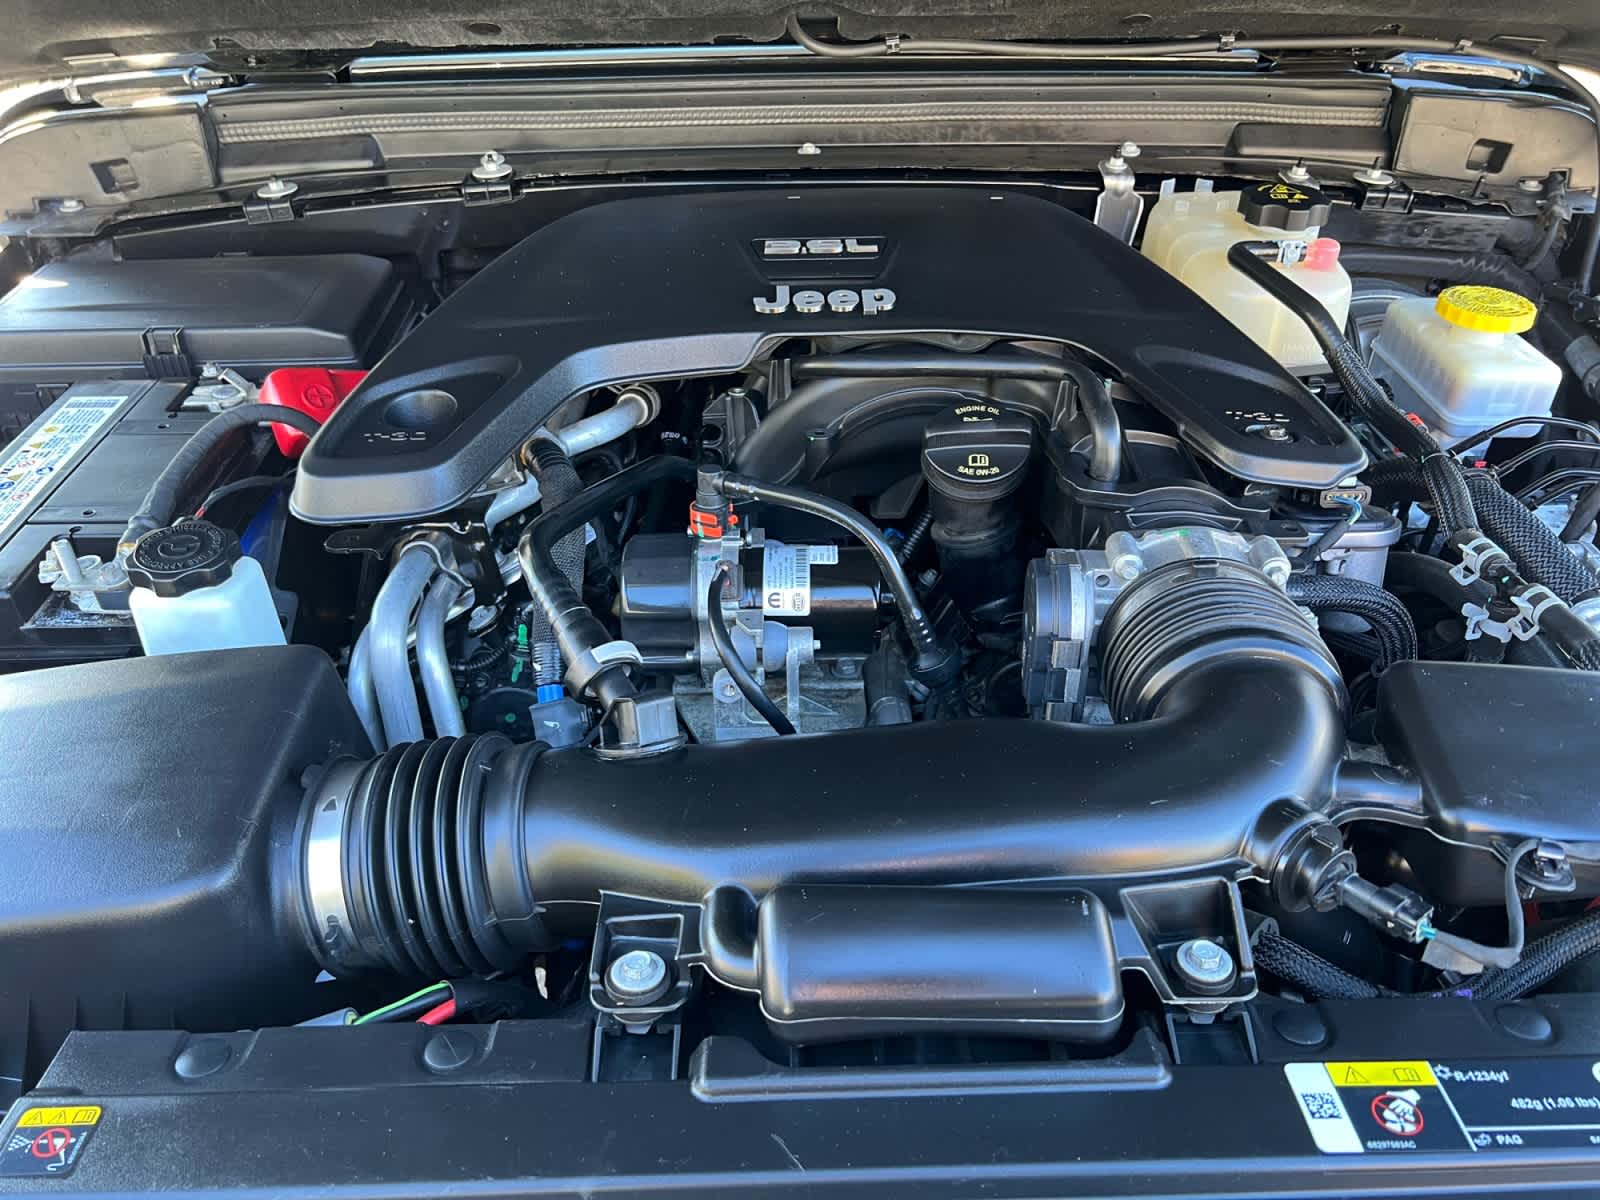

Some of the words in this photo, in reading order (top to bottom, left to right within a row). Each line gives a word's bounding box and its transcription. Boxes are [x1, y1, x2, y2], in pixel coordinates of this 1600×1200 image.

[752, 285, 897, 316] Jeep
[954, 405, 986, 415] ENGINE
[987, 406, 1000, 416] OIL
[957, 465, 974, 475] SAE
[975, 466, 1000, 476] 0W-20
[1511, 1097, 1543, 1111] 482g
[1495, 1134, 1524, 1145] PAG
